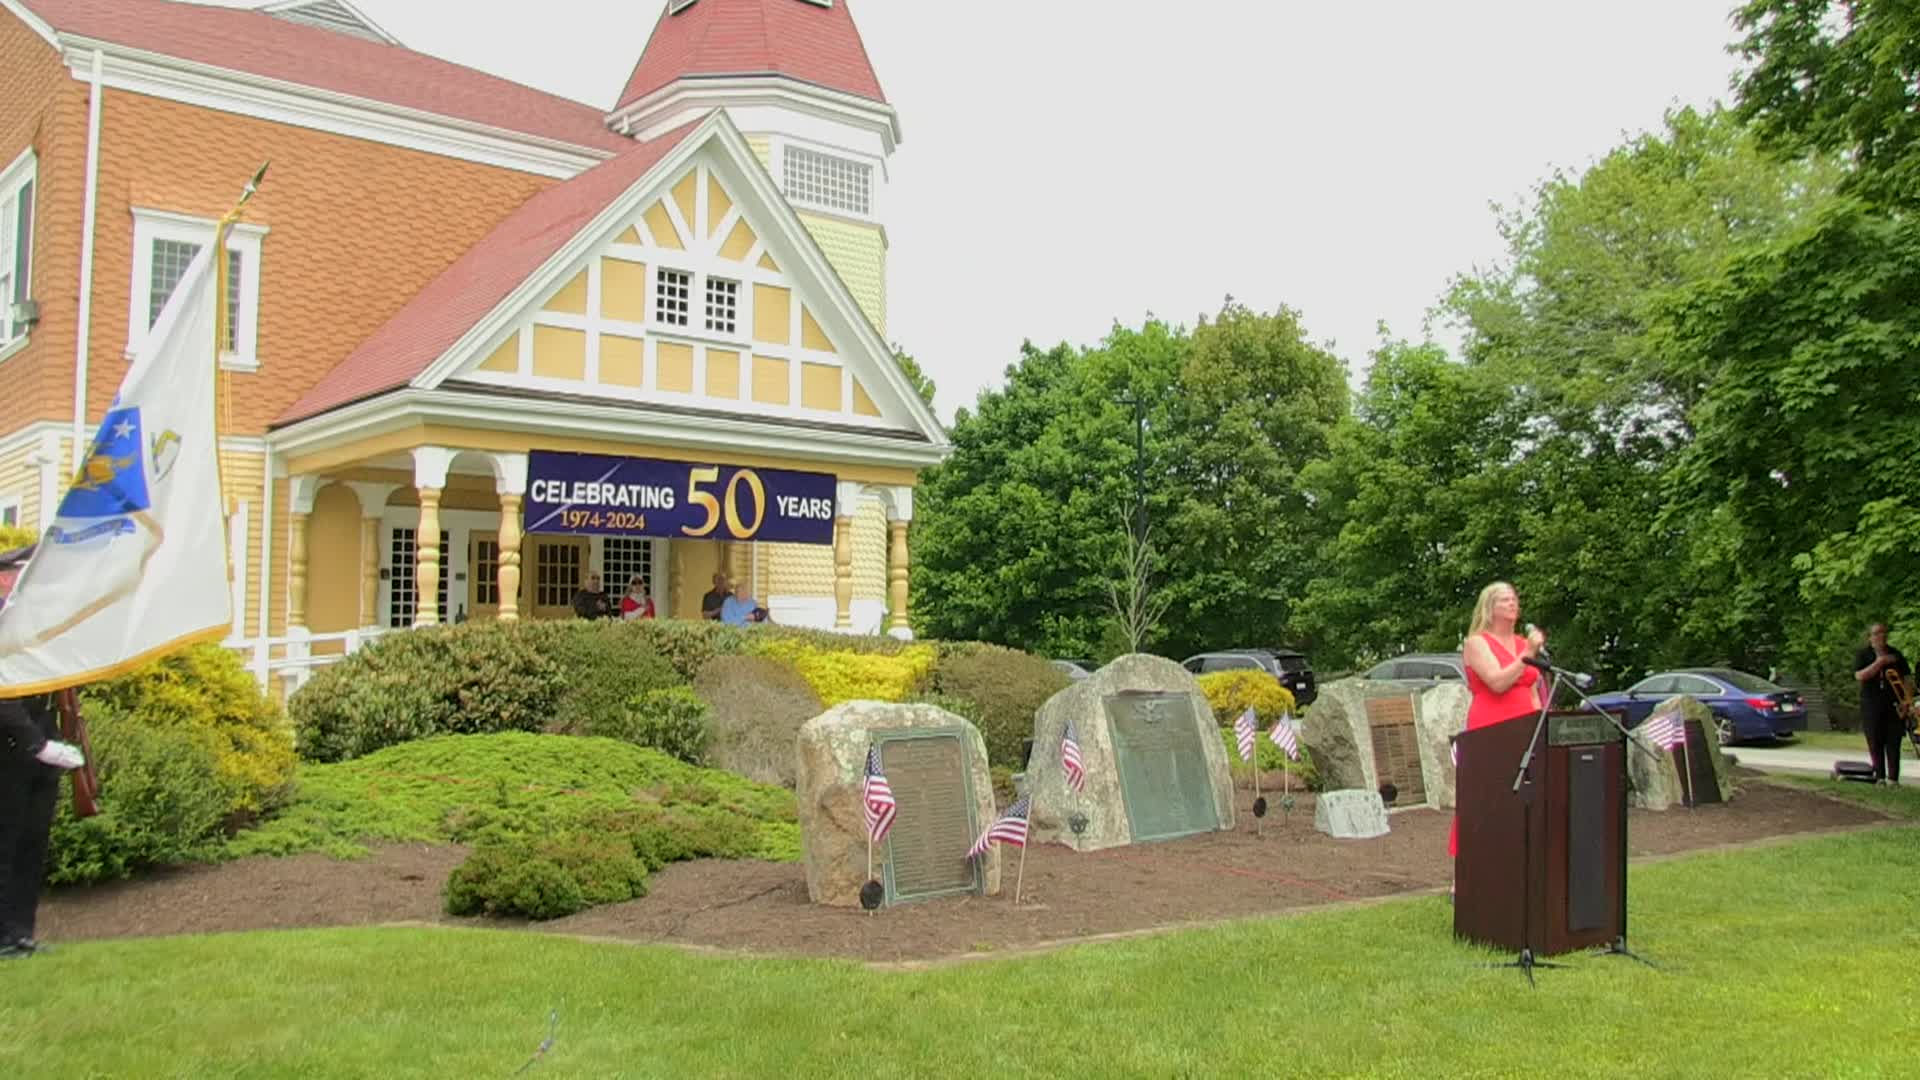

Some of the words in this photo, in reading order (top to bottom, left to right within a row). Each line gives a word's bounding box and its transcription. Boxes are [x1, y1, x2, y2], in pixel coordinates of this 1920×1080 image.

[530, 479, 675, 509] CELEBRATING
[681, 465, 766, 539] 50
[777, 495, 832, 520] YEARS
[560, 510, 646, 529] 1974-2024
